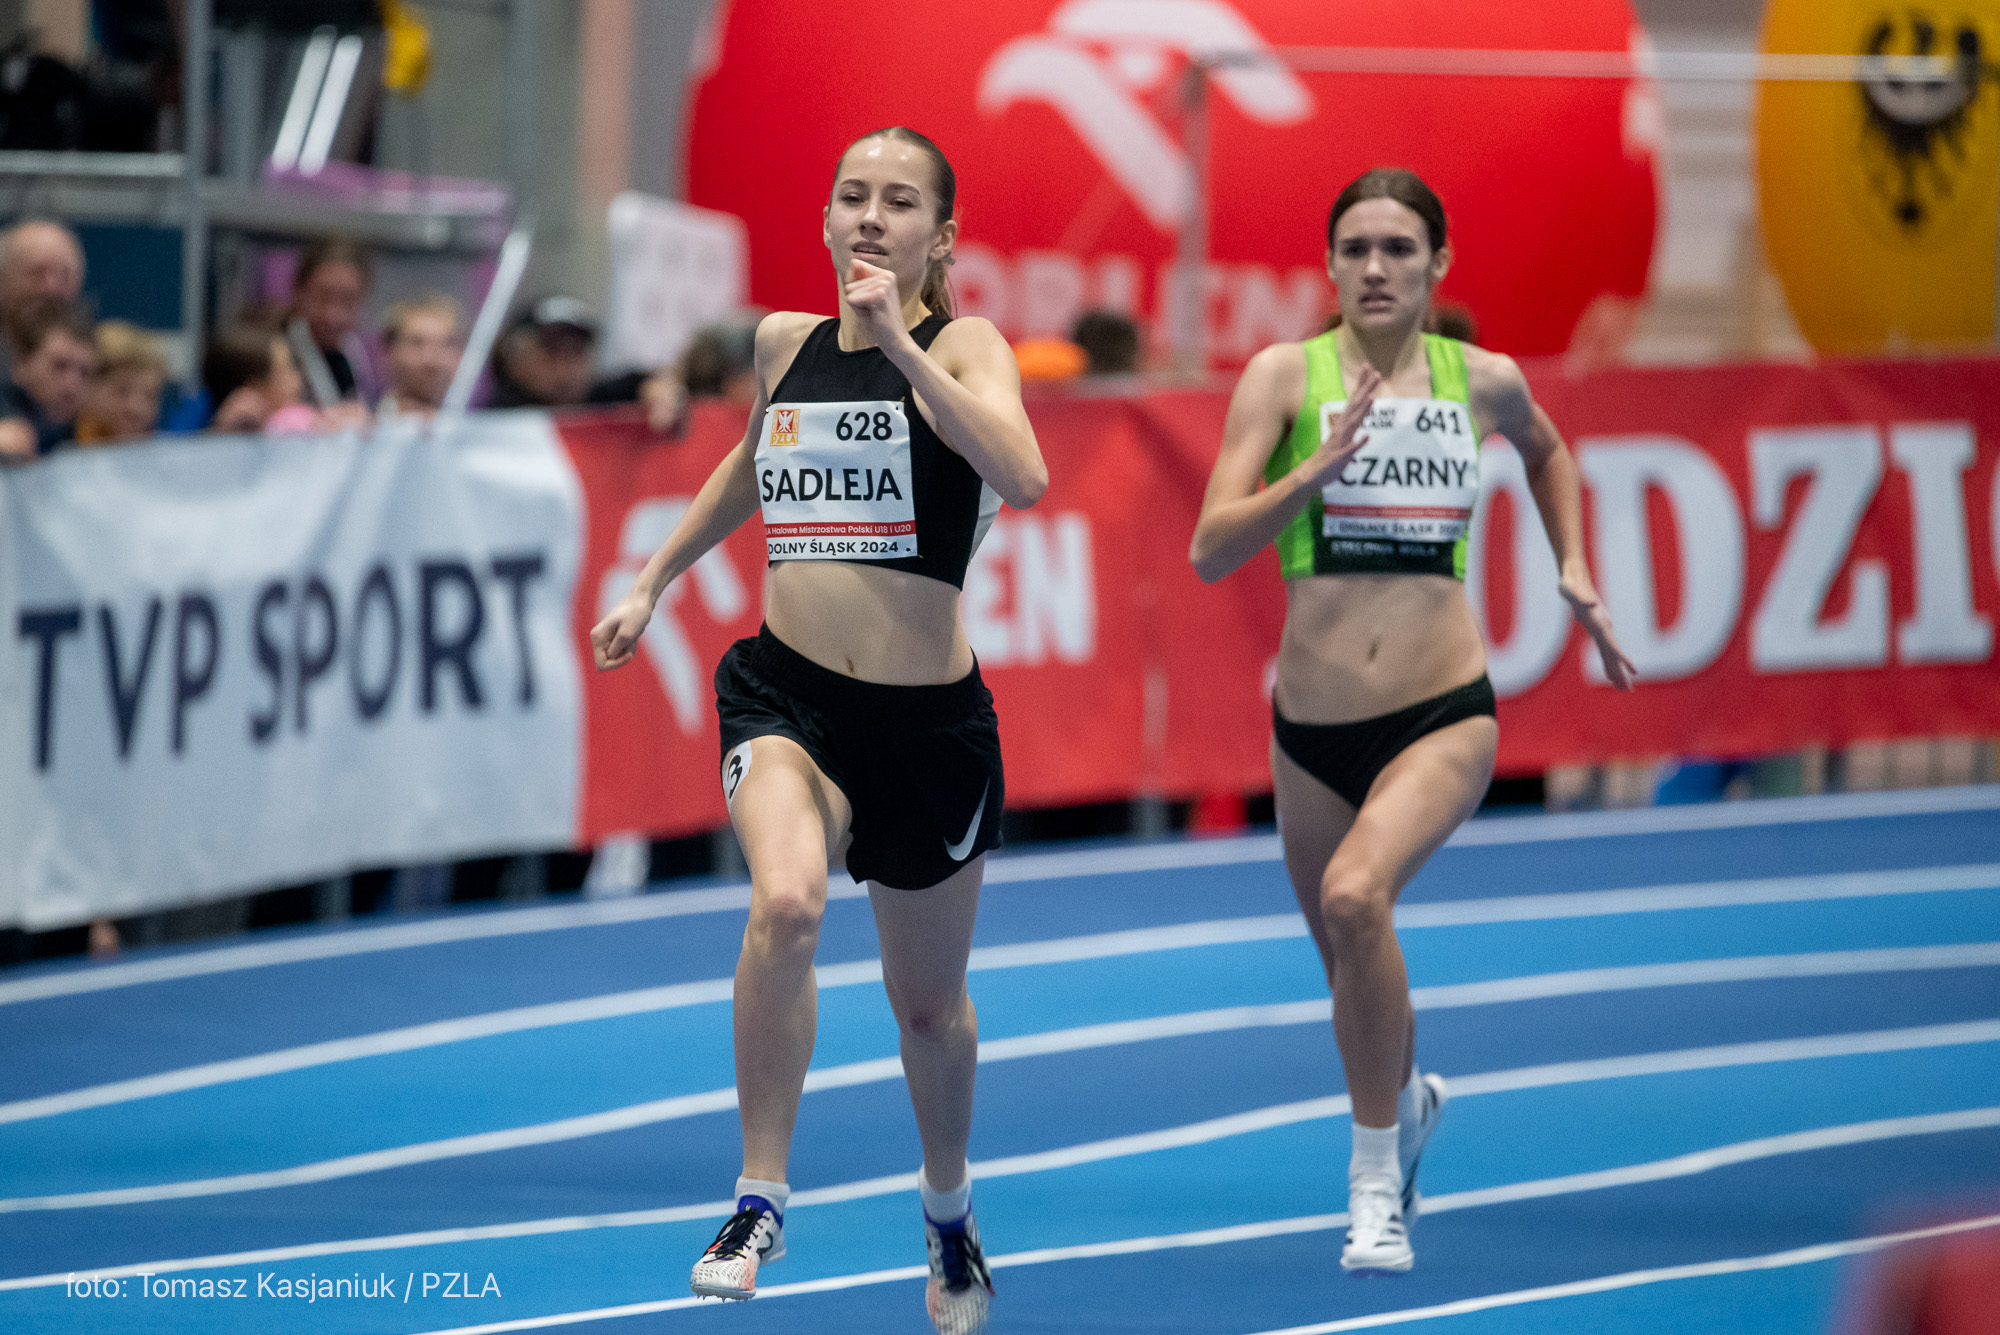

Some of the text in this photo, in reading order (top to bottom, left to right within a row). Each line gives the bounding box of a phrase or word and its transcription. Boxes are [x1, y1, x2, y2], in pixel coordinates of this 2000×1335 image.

[836, 411, 892, 441] 628
[1416, 407, 1463, 435] 641
[771, 433, 796, 445] PZLA
[762, 467, 903, 503] SADLEJA
[1339, 456, 1468, 487] CZARNY
[772, 527, 797, 535] Halowe
[798, 526, 846, 534] Mistrzostwa
[848, 525, 873, 534] Polski
[874, 525, 888, 533] U18
[895, 524, 912, 533] U20
[768, 538, 899, 556] DOLNY ŚLĄSK 2024
[1263, 420, 2000, 702] ODZI
[17, 548, 548, 776] TVP SPORT
[727, 754, 743, 800] 3
